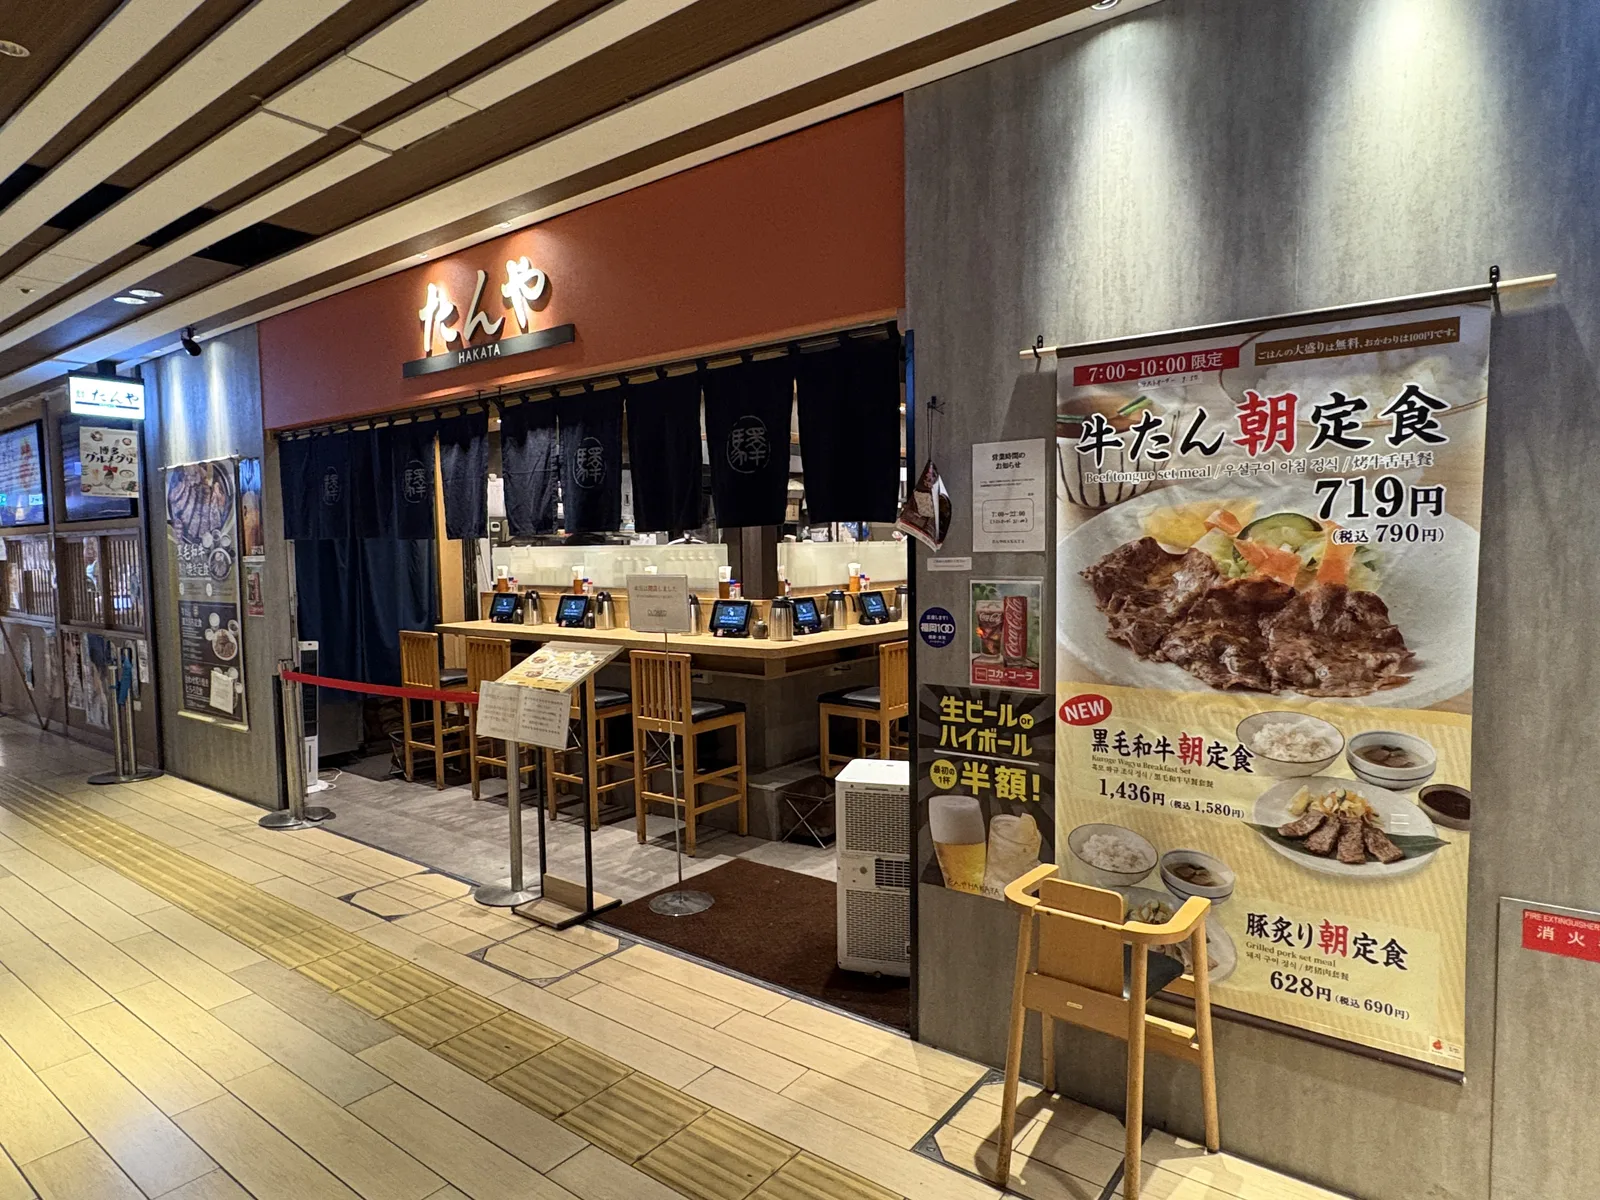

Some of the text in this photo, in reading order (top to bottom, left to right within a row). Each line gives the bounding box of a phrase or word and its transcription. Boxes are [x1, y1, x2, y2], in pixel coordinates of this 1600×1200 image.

[419, 256, 546, 352] たんや
[458, 344, 500, 364] HAKATA
[1257, 328, 1457, 360] ごはんの大盛りは無料、おかわりは100円です。
[1191, 352, 1223, 370] 限定
[91, 389, 139, 405] たんや
[1076, 384, 1449, 466] 牛たん朝定食
[99, 446, 119, 455] 博多
[996, 462, 1021, 470] お知らせ
[1086, 471, 1112, 483] Beef
[1113, 470, 1155, 483] tongue
[1157, 469, 1176, 479] set
[1179, 466, 1211, 478] meal
[1224, 461, 1275, 477] 우설구이
[1280, 459, 1306, 474] 아침
[1311, 457, 1339, 472] 정식
[1354, 451, 1434, 470] 烤牛舌早餐
[1315, 477, 1445, 520] 719円
[1332, 523, 1444, 544] (税込 790円)
[920, 622, 955, 634] 福岡100
[987, 668, 1033, 681] コカ・コーラ
[939, 695, 1033, 728] 生ビール or
[1064, 699, 1105, 721] NEW
[939, 724, 1033, 757] ハイボール
[1091, 728, 1254, 774] 黒毛和牛朝定食
[933, 765, 955, 775] 最初の
[1091, 755, 1191, 775] Kuroge Wagyu Breakfast Set
[938, 776, 951, 785] 1杯
[960, 761, 1040, 803] 半額!
[1099, 778, 1165, 806] 1,436円
[1169, 799, 1245, 819] (税込 1,580円)
[1524, 911, 1542, 921] FIRE
[1246, 912, 1408, 971] 豚炙り朝定食
[1537, 925, 1600, 947] 消火
[1246, 941, 1336, 968] Grilled pork set meal
[1263, 955, 1279, 965] 구이
[1270, 970, 1331, 1002] 628円
[1335, 994, 1410, 1020] (税込 690円)
